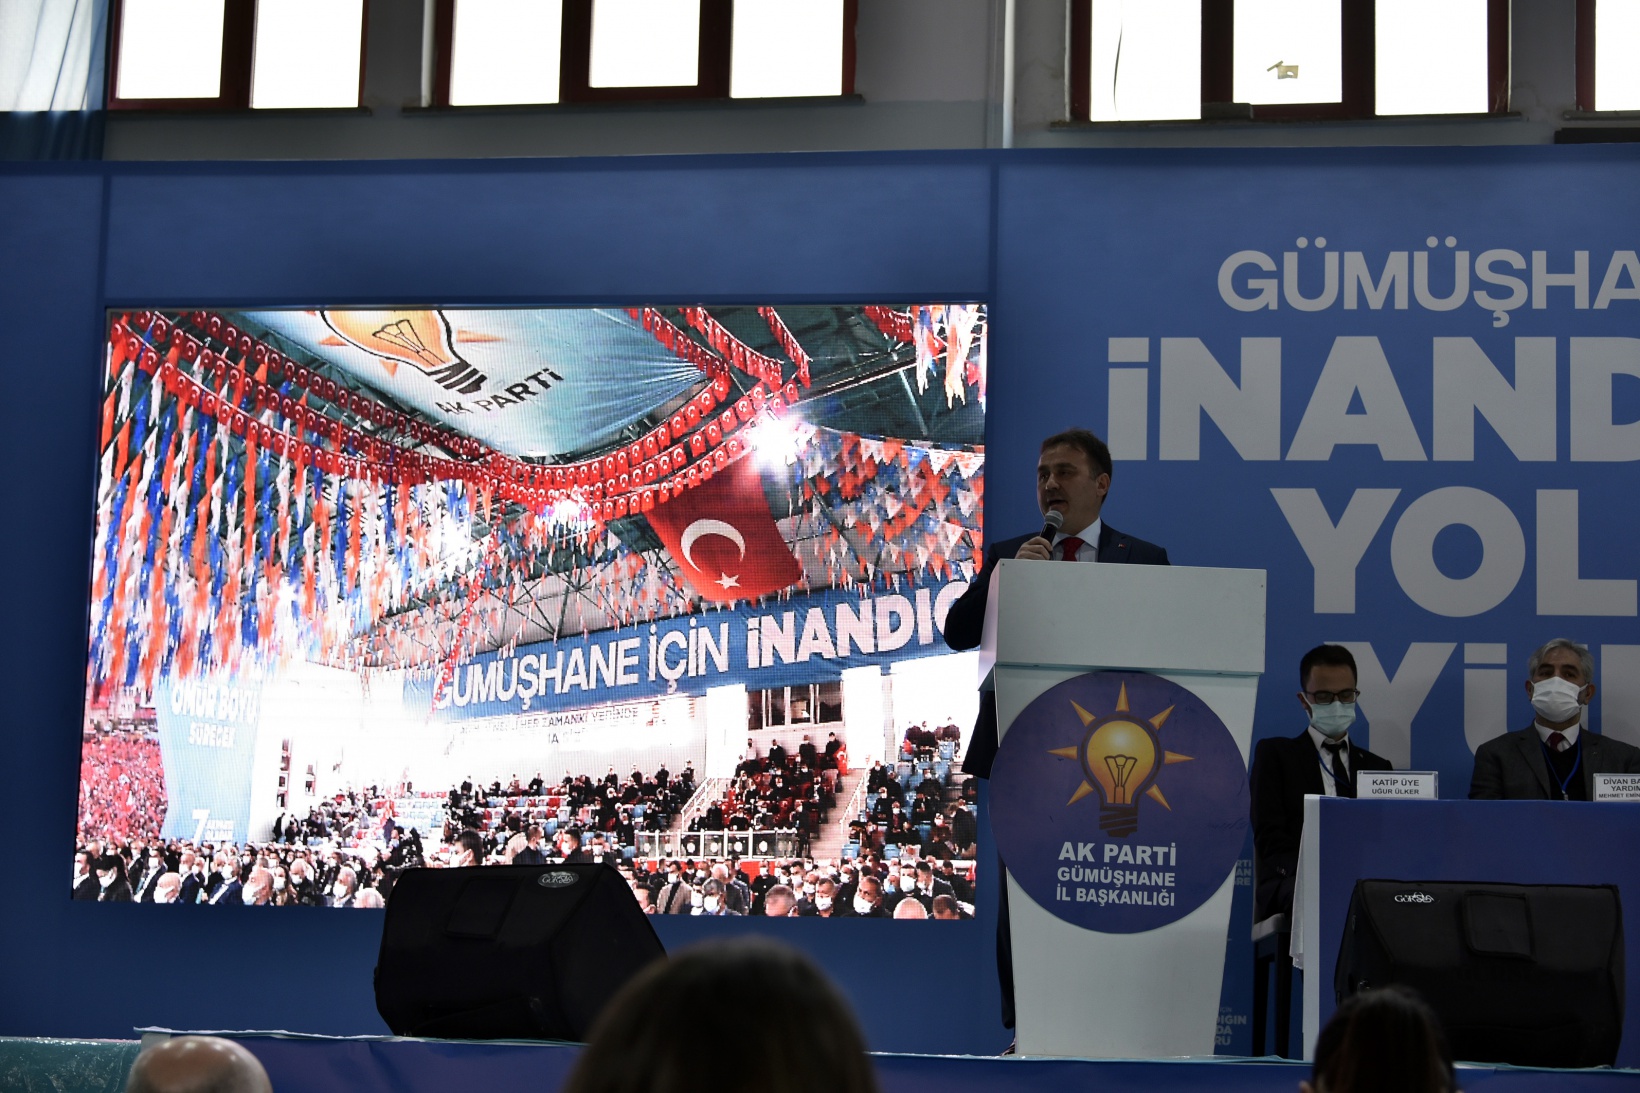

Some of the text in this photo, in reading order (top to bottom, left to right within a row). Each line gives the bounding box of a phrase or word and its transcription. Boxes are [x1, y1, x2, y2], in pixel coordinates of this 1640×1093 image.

[1217, 236, 1640, 328] GÜMÜŞHA
[473, 367, 565, 412] PARTİ
[1269, 486, 1638, 618] YOL
[647, 617, 729, 695] İÇİN
[1371, 787, 1393, 795] UĞUR
[1372, 777, 1420, 787] KATİP ÜYE
[1603, 777, 1628, 785] DİVAN
[1058, 841, 1176, 866] AK PARTİ
[1057, 865, 1176, 888] GÜMÜŞHANE
[1056, 883, 1175, 907] İL BAŞKANLIĞI
